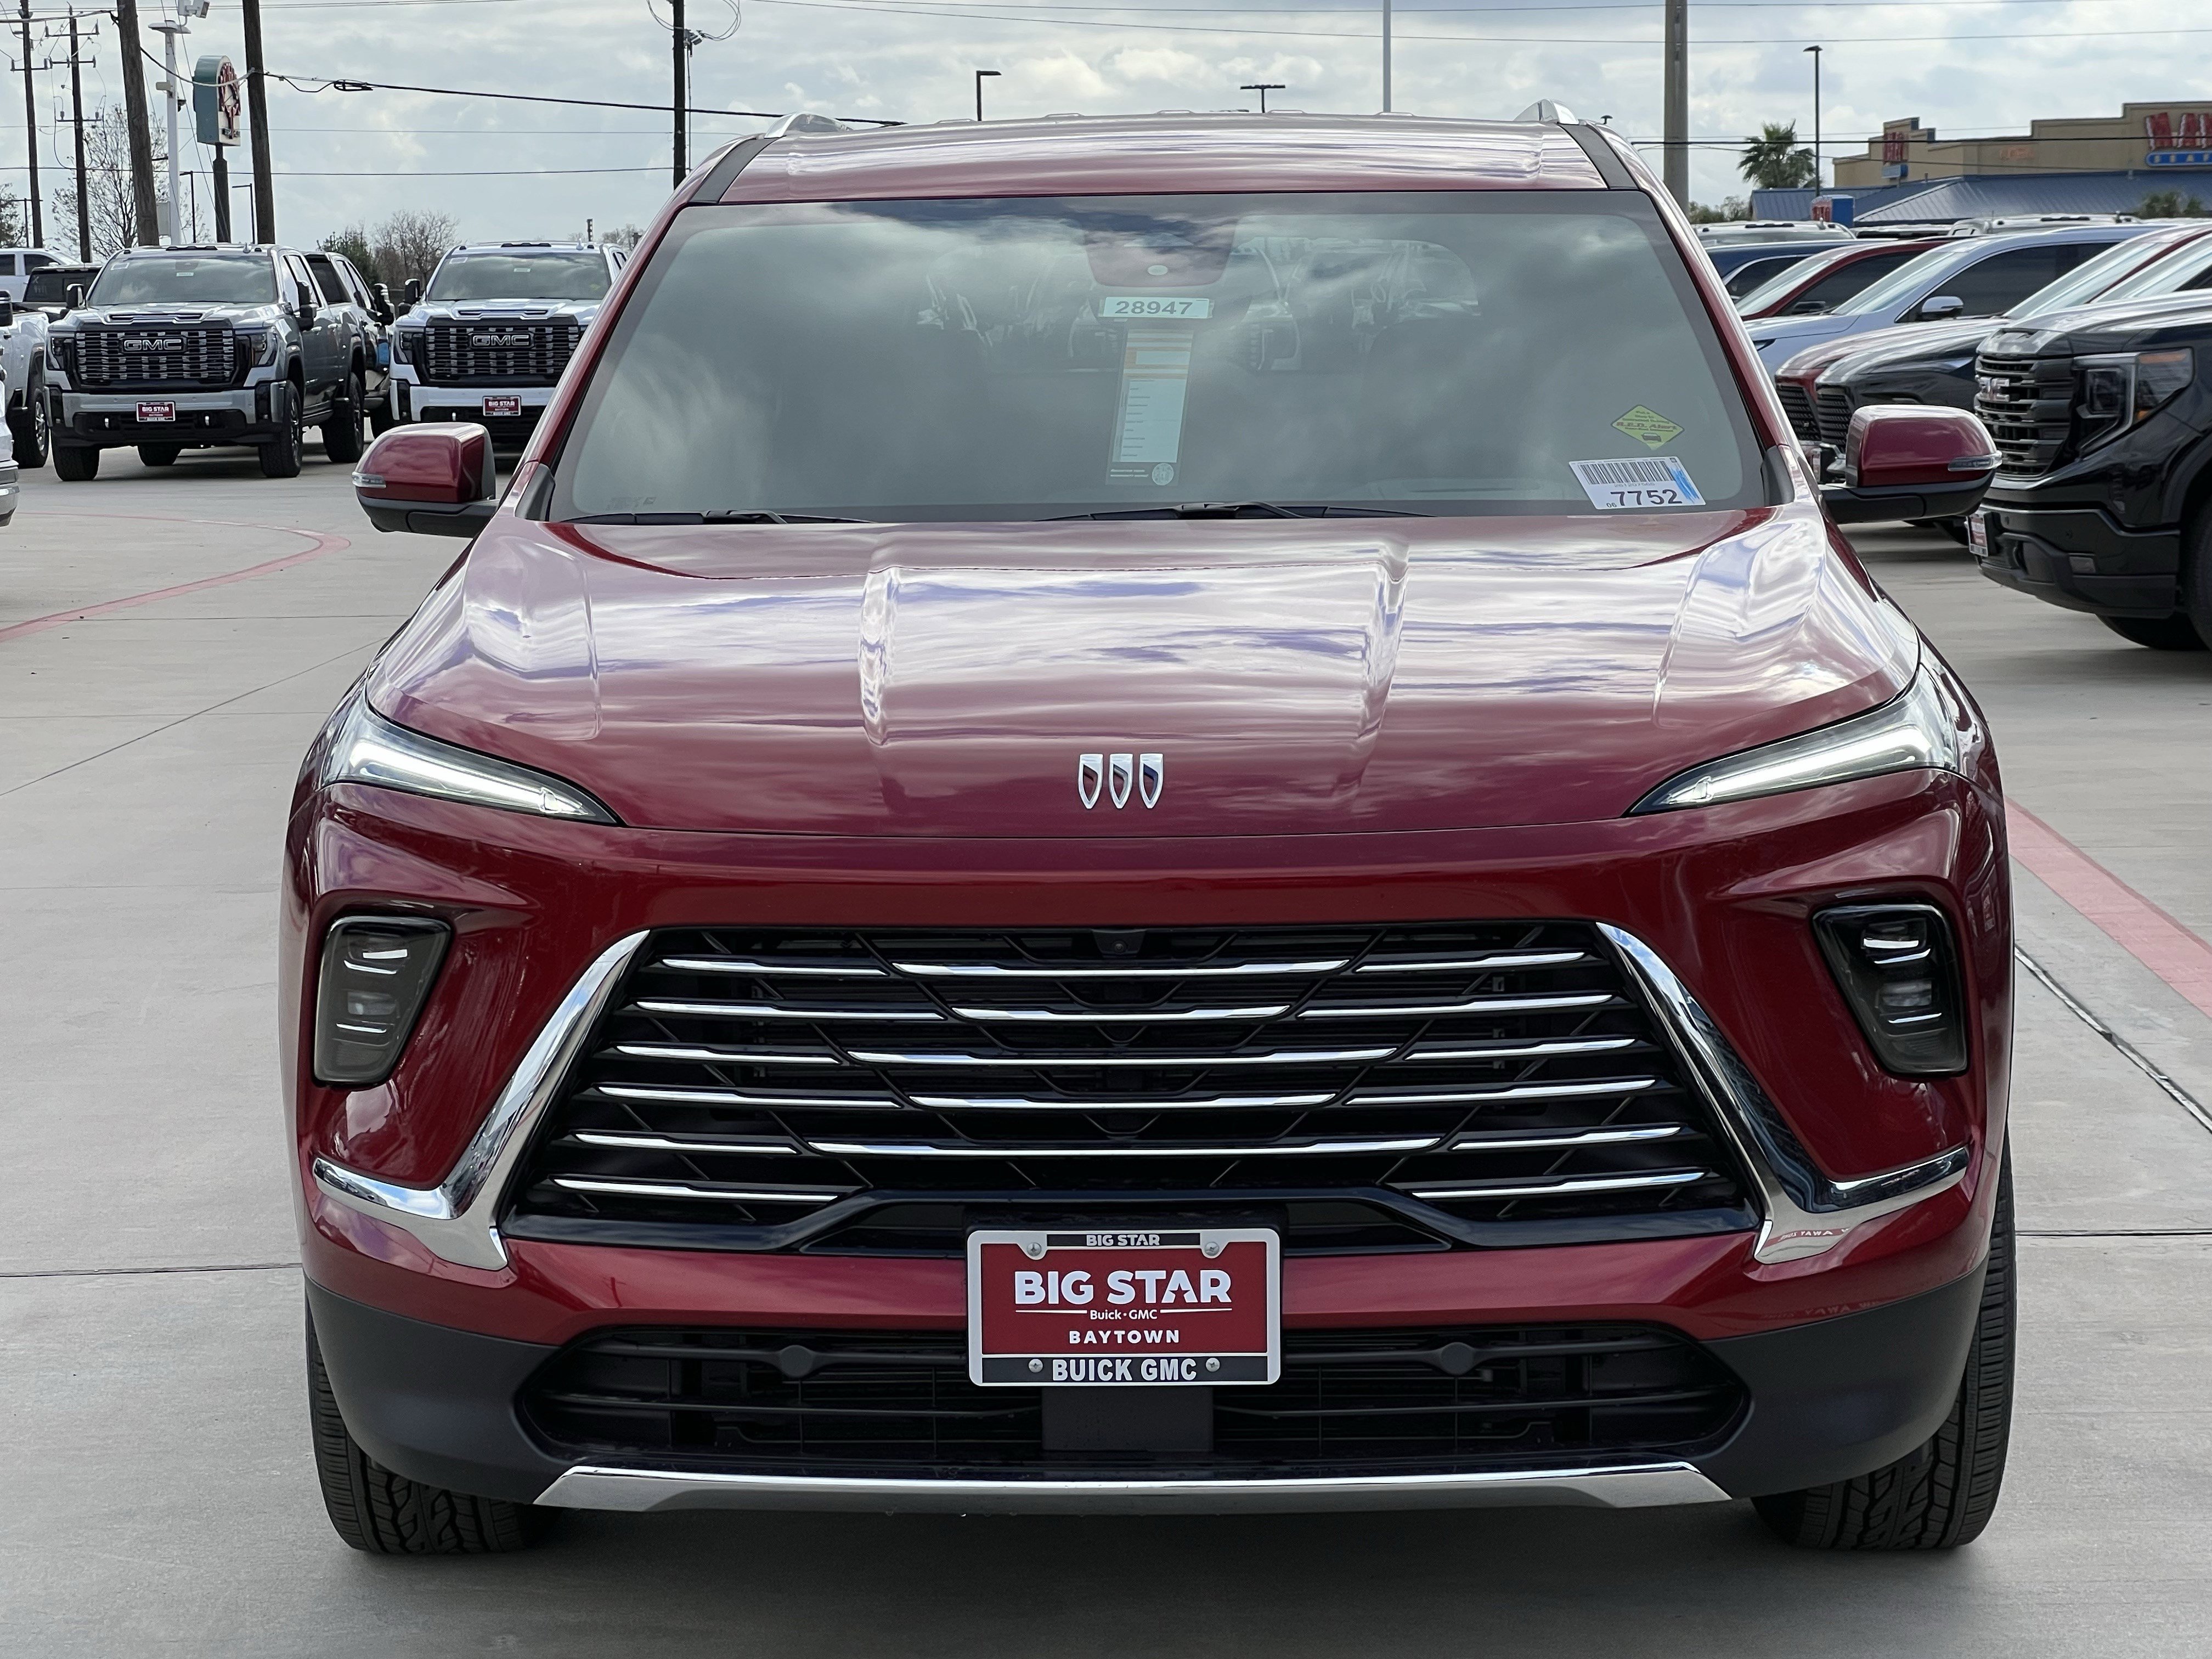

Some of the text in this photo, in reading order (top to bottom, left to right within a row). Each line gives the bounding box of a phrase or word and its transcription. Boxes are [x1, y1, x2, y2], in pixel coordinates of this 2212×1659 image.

[1114, 301, 1193, 315] 28947
[124, 338, 182, 351] GMC
[472, 335, 529, 346] GMC
[1610, 489, 1683, 506] 7752
[1086, 1234, 1160, 1246] BIG STAR
[1014, 1269, 1232, 1305] BIG STAR
[1069, 1329, 1180, 1344] BAYTOWN
[1052, 1358, 1197, 1381] BUICK GMC
